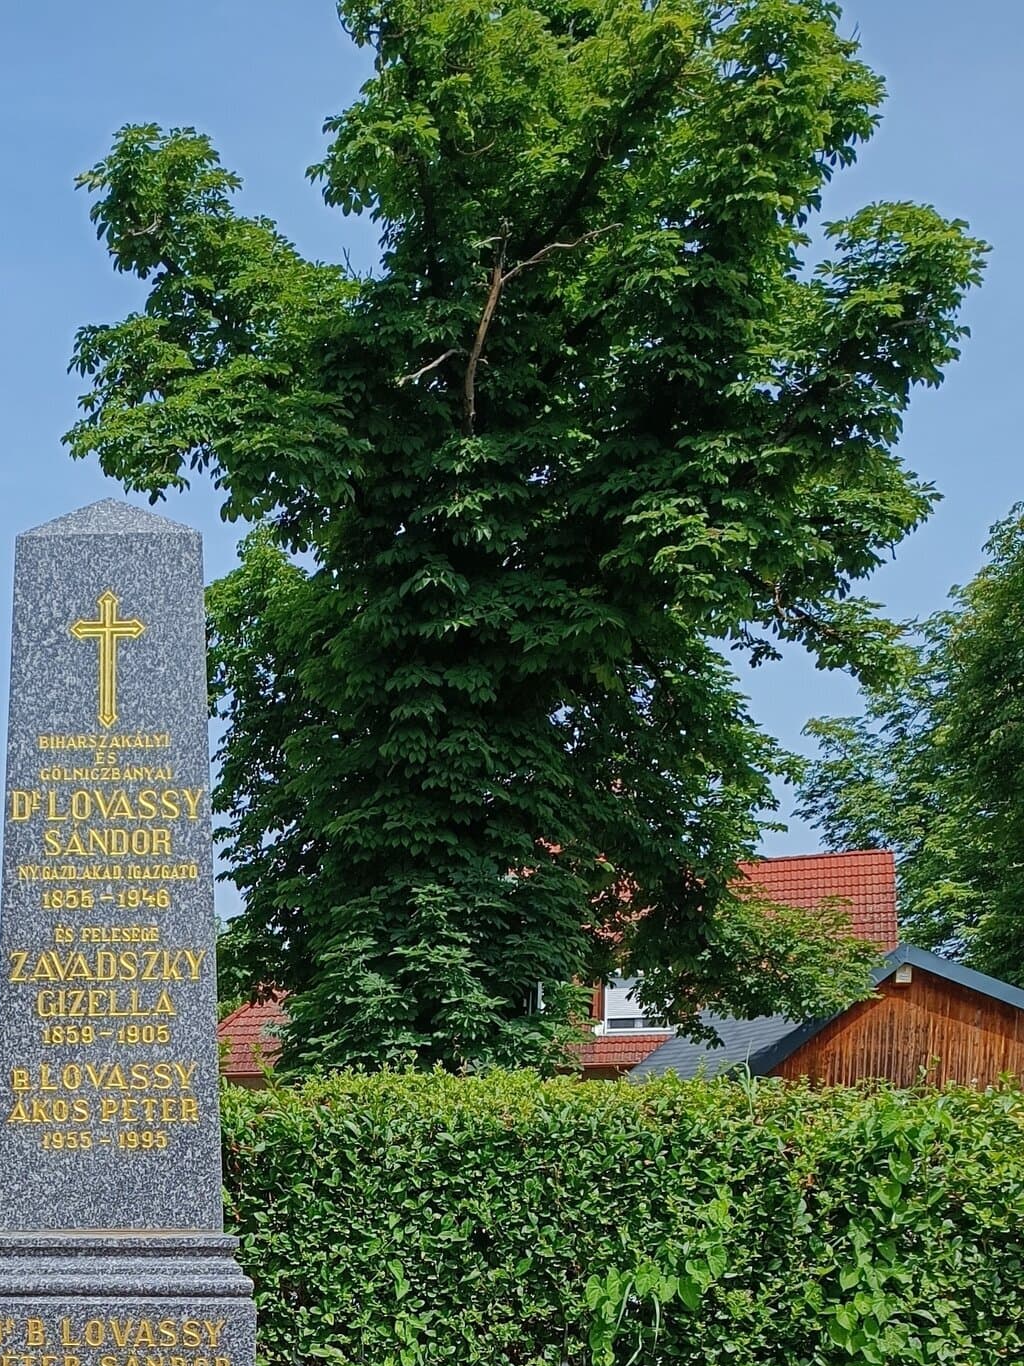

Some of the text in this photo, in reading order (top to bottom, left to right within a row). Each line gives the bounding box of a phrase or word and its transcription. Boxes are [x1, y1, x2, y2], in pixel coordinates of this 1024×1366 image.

[95, 750, 116, 764] ÉS
[47, 789, 203, 821] LOVASSY
[45, 822, 172, 857] SÁNDOR
[55, 924, 159, 943] ÉS FELESÉGE
[9, 950, 206, 982] ZAVADSZKY
[37, 988, 176, 1017] GIZELLA
[39, 1062, 197, 1090] LOVASSY
[7, 1092, 199, 1123] ÁKOS PÉTER
[61, 1318, 226, 1348] LOVASSY
